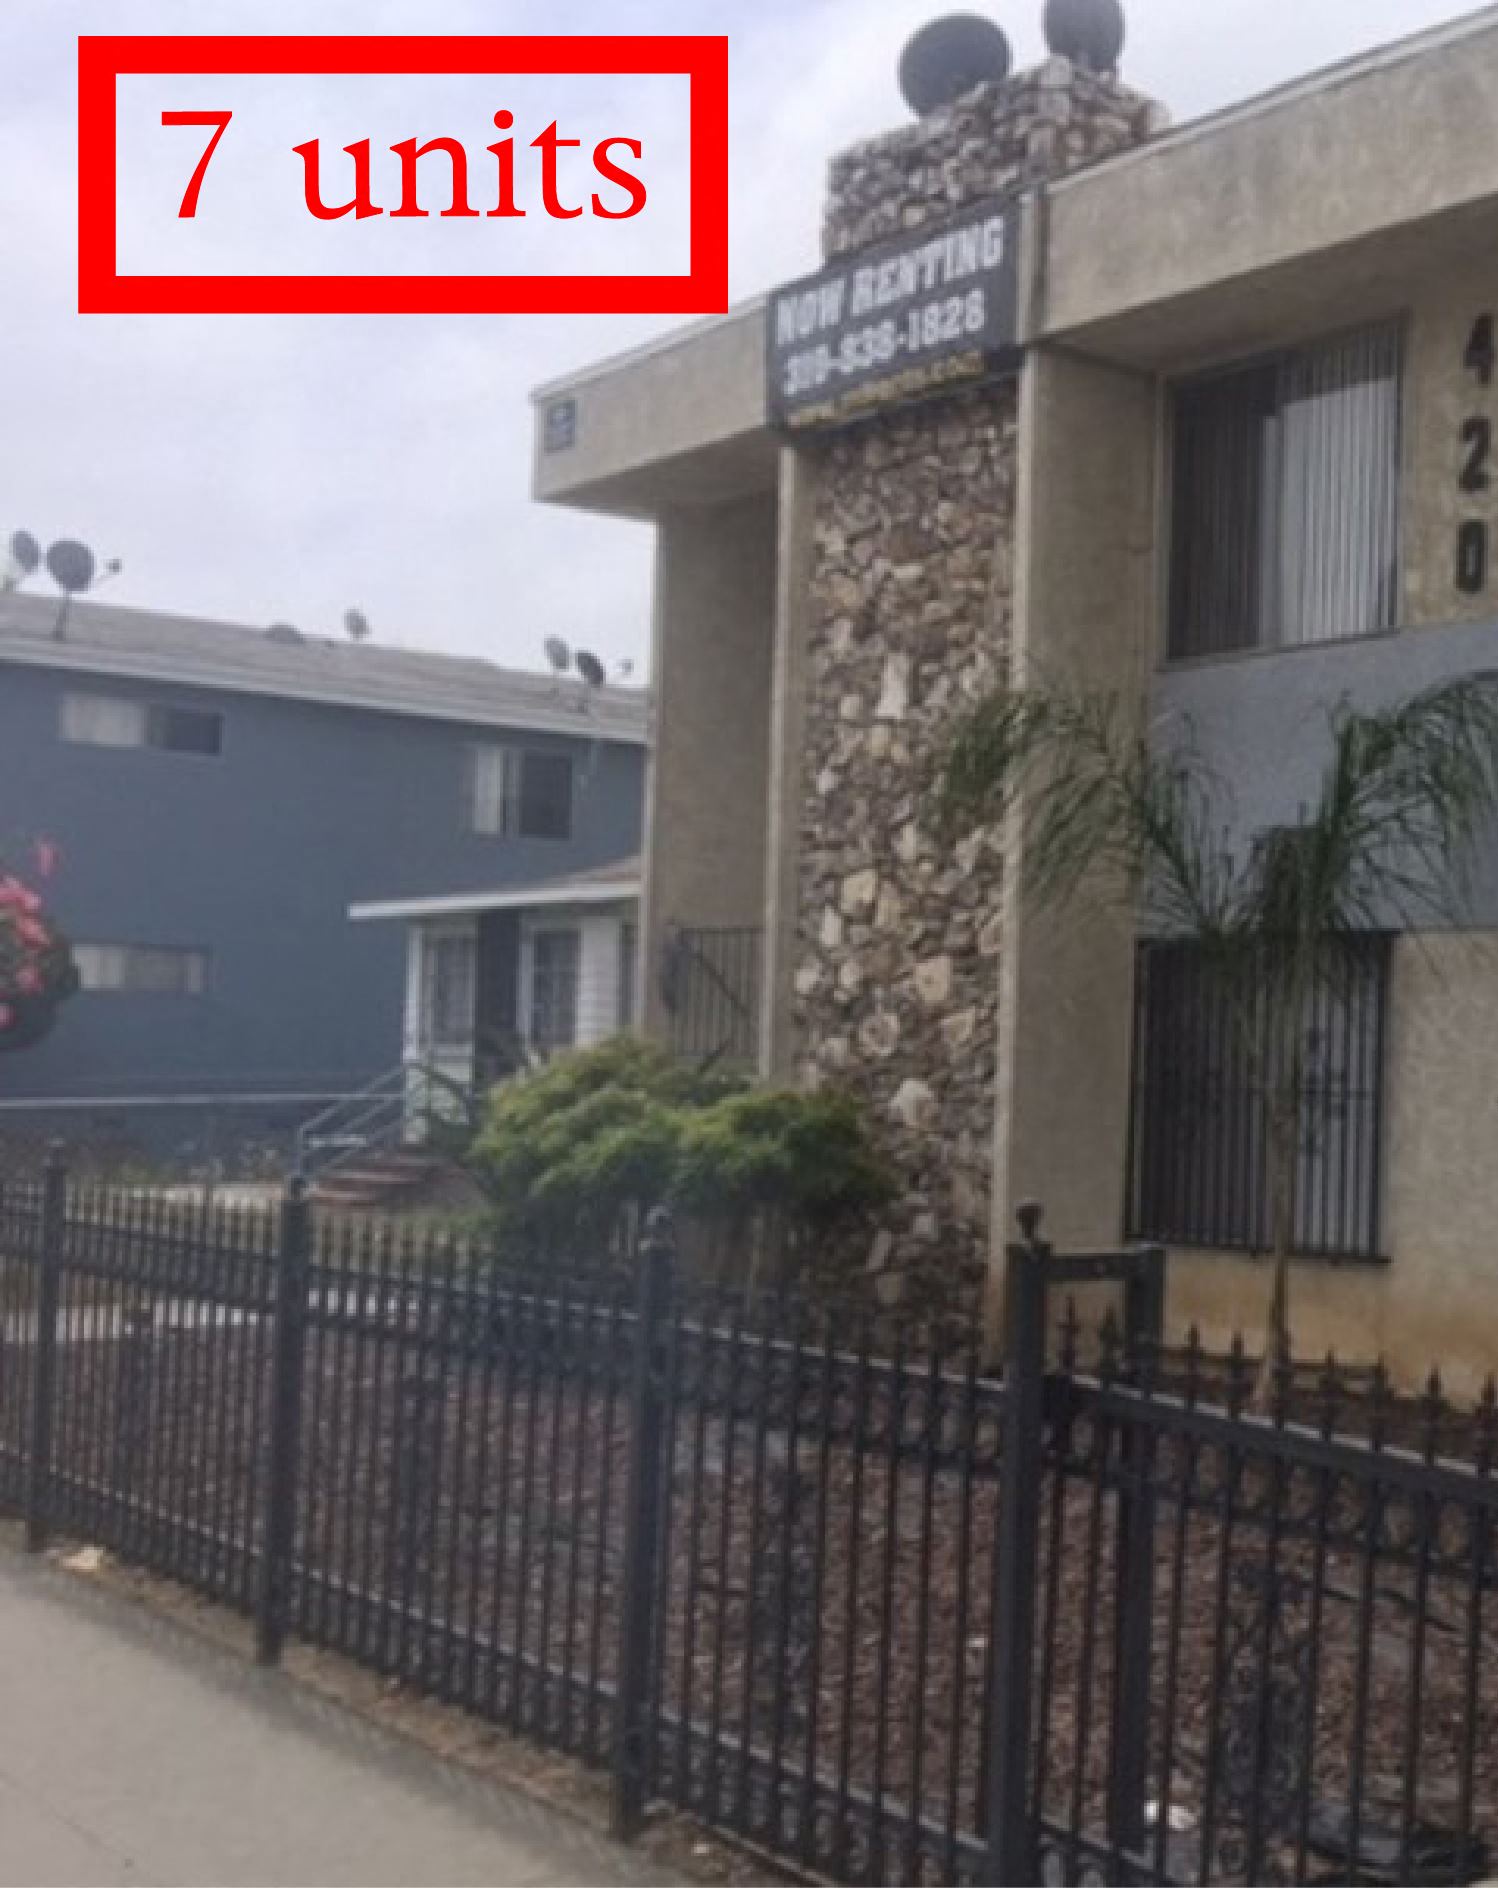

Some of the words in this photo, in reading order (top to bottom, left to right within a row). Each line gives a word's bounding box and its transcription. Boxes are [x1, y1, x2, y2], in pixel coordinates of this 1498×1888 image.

[777, 279, 845, 346] NOW
[852, 215, 1003, 317] RENTING
[1456, 312, 1496, 593] 420
